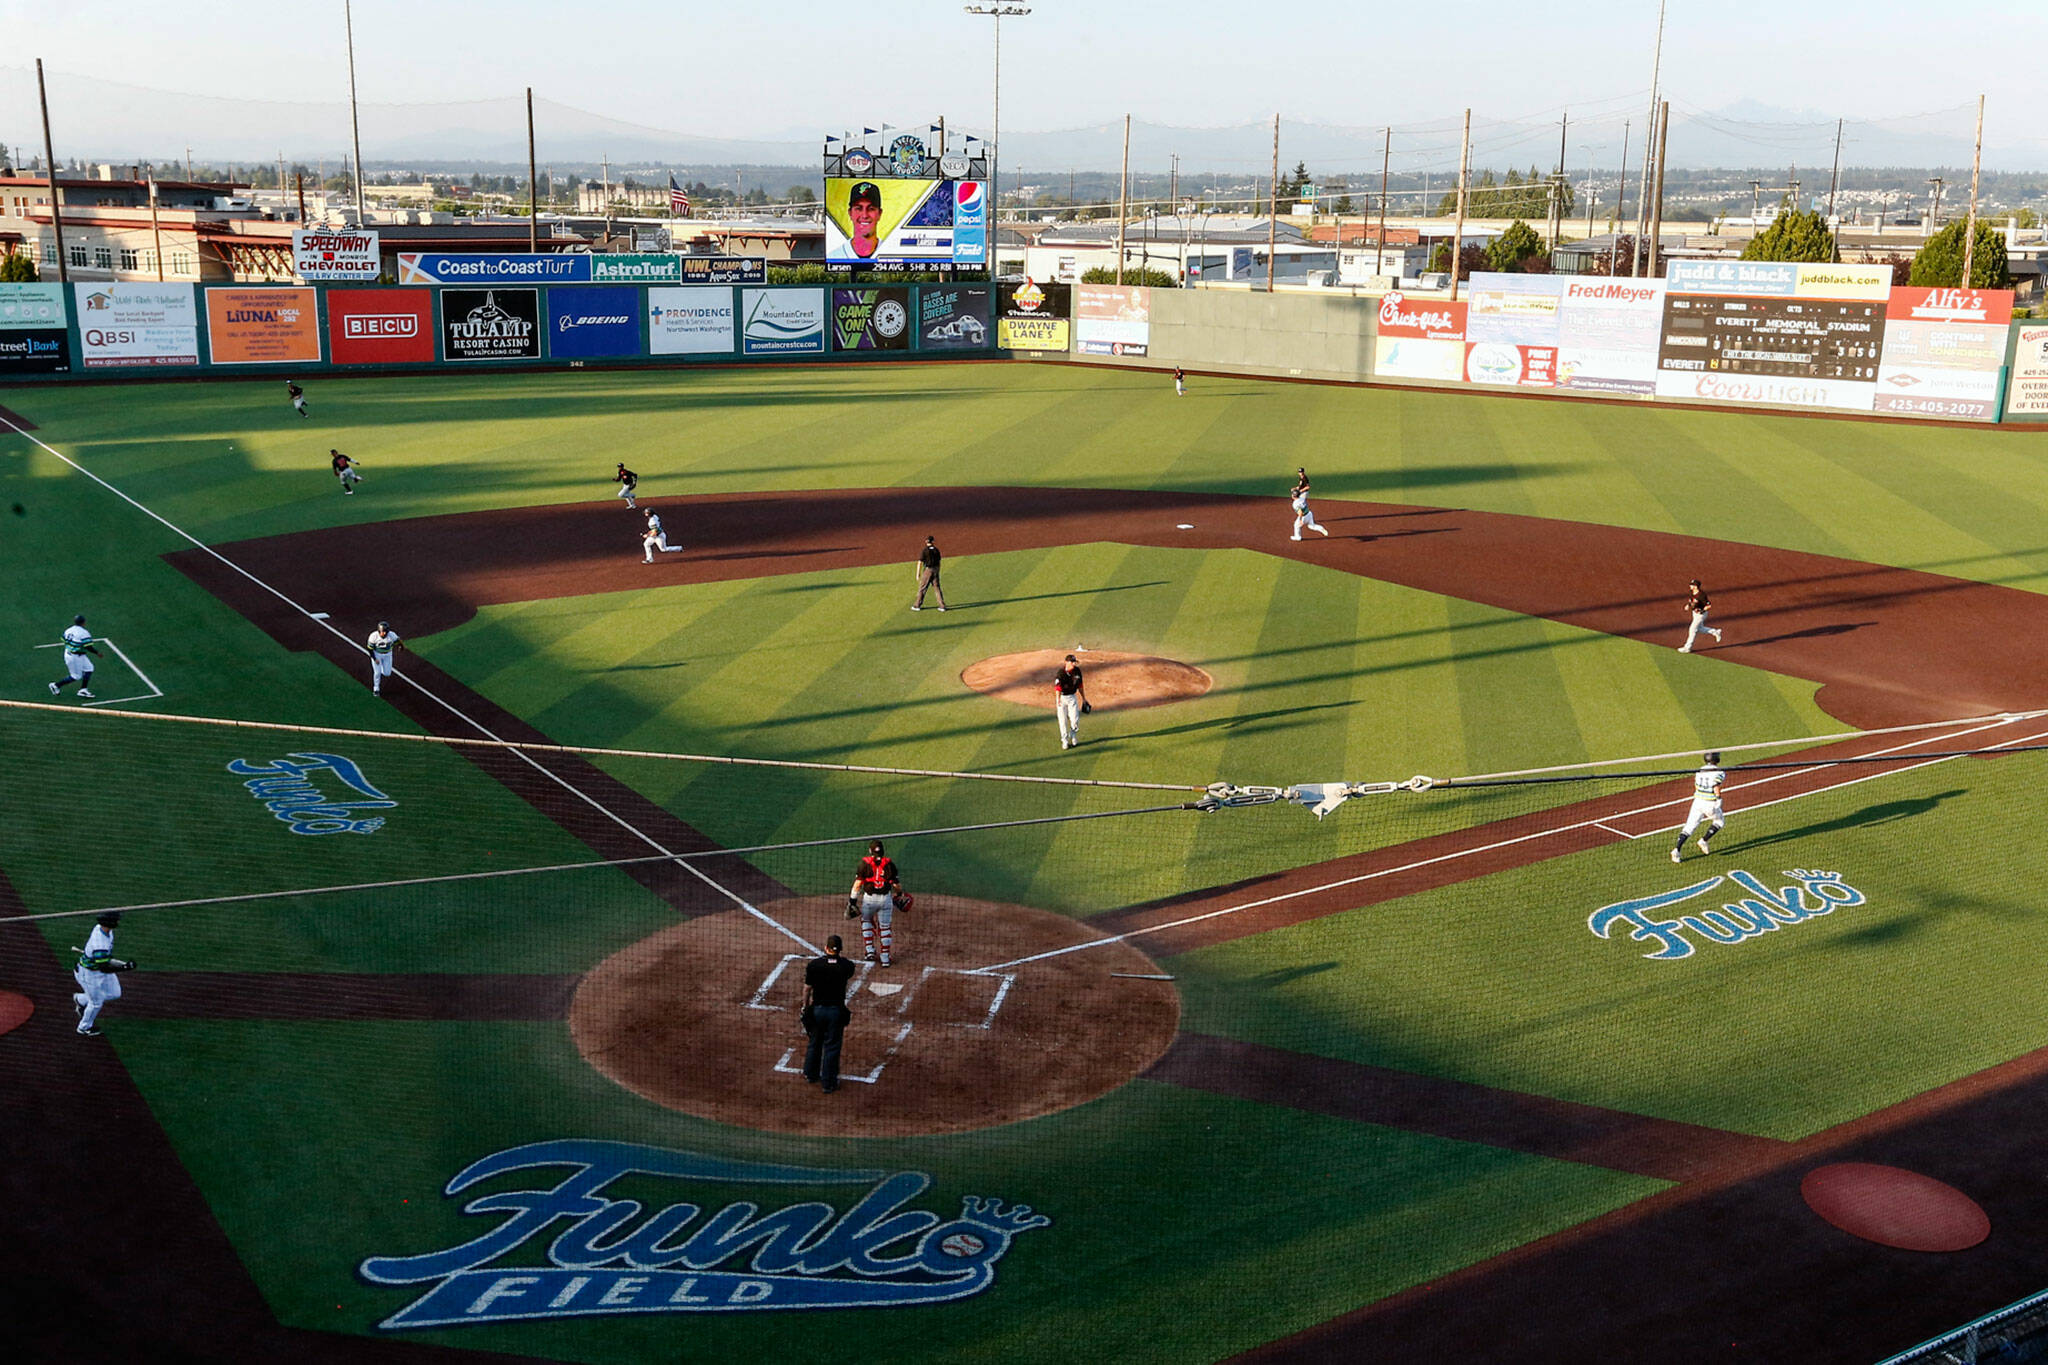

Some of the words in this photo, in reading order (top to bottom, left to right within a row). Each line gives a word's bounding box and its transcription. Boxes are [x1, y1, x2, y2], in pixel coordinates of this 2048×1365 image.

[957, 215, 982, 226] pepsi
[301, 235, 372, 252] SPEEDWAY
[299, 261, 376, 271] CHEVROLET
[596, 262, 676, 276] AstroTurf
[684, 260, 712, 273] NWL
[709, 271, 740, 283] AquaSox
[1671, 263, 1715, 284] judd
[1718, 264, 1735, 280] &
[1738, 266, 1793, 283] black
[1800, 273, 1880, 286] juddblack.com
[1568, 283, 1605, 298] Fred
[1606, 285, 1657, 303] Meyer
[1920, 288, 1983, 310] Alfy's
[923, 296, 945, 311] BASES
[945, 291, 958, 304] ARE
[226, 310, 278, 323] LiUNA!
[278, 308, 300, 316] LOCAL
[666, 308, 731, 318] PROVIDENCE
[763, 311, 814, 319] MountainCrest
[838, 305, 872, 318] GAME
[577, 316, 629, 324] BOEING
[845, 318, 866, 332] ON!
[1009, 321, 1057, 330] DWAYNE
[1715, 317, 1760, 327] EVERETT
[1765, 319, 1821, 330] MEMORIAL
[1827, 321, 1871, 332] STADIUM
[450, 322, 532, 338] TULALIP
[700, 326, 731, 335] Washington
[33, 340, 60, 351] Bank
[86, 330, 136, 347] QBSI
[454, 338, 490, 349] RESORT
[493, 337, 530, 348] CASINO
[751, 341, 817, 350] mountaincrestcu.com
[1838, 346, 1845, 356] 3
[1857, 347, 1864, 357] 5
[1868, 348, 1876, 358] 0
[1663, 358, 1706, 370] EVERETT
[1836, 366, 1843, 376] 2
[1855, 367, 1862, 377] 2
[1866, 368, 1874, 378] 0
[1696, 373, 1763, 400] Coors
[1769, 384, 1830, 403] LIGHT
[1888, 398, 1985, 415] 425-405-2077
[1588, 868, 1866, 960] Funko
[360, 1138, 1052, 1296] Funko
[465, 1275, 775, 1315] FIELD
